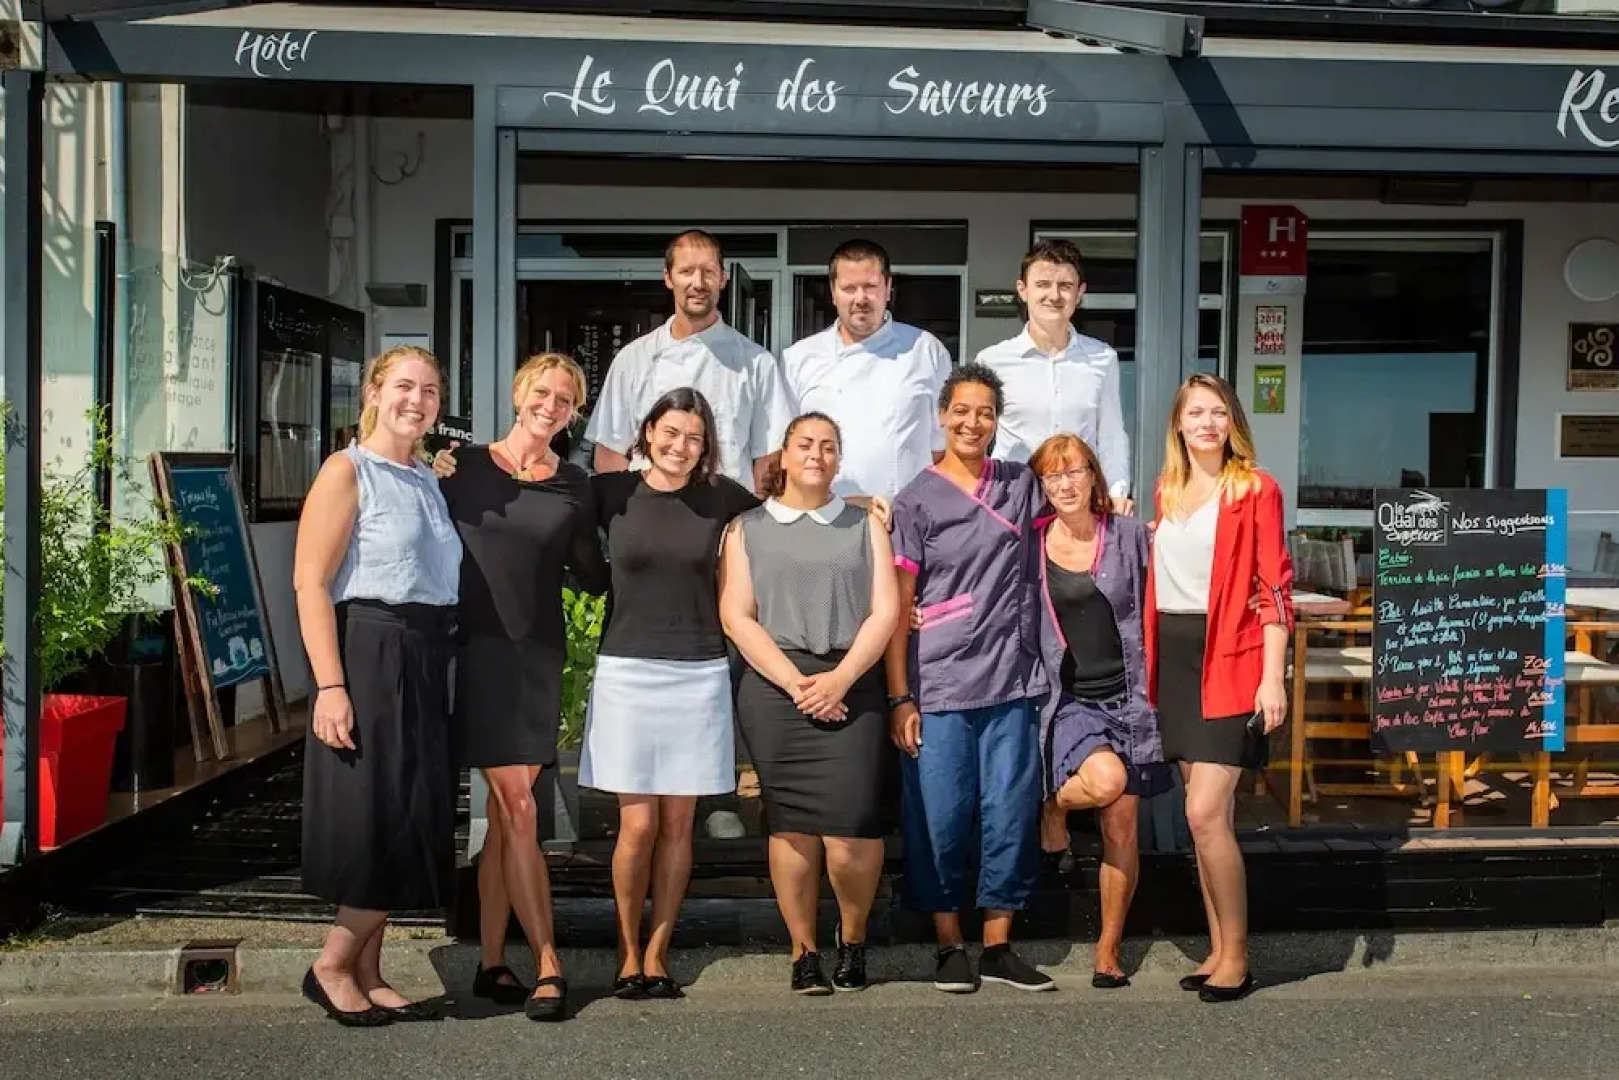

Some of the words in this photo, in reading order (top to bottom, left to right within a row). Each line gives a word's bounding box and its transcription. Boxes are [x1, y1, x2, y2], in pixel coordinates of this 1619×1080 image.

[235, 31, 318, 76] Hôtel
[543, 55, 616, 117] Le
[638, 58, 743, 116] Quai
[776, 58, 846, 113] des
[884, 65, 1054, 117] Saveurs
[1269, 217, 1296, 242] H
[1418, 516, 1438, 529] des
[1452, 512, 1480, 530] Nos
